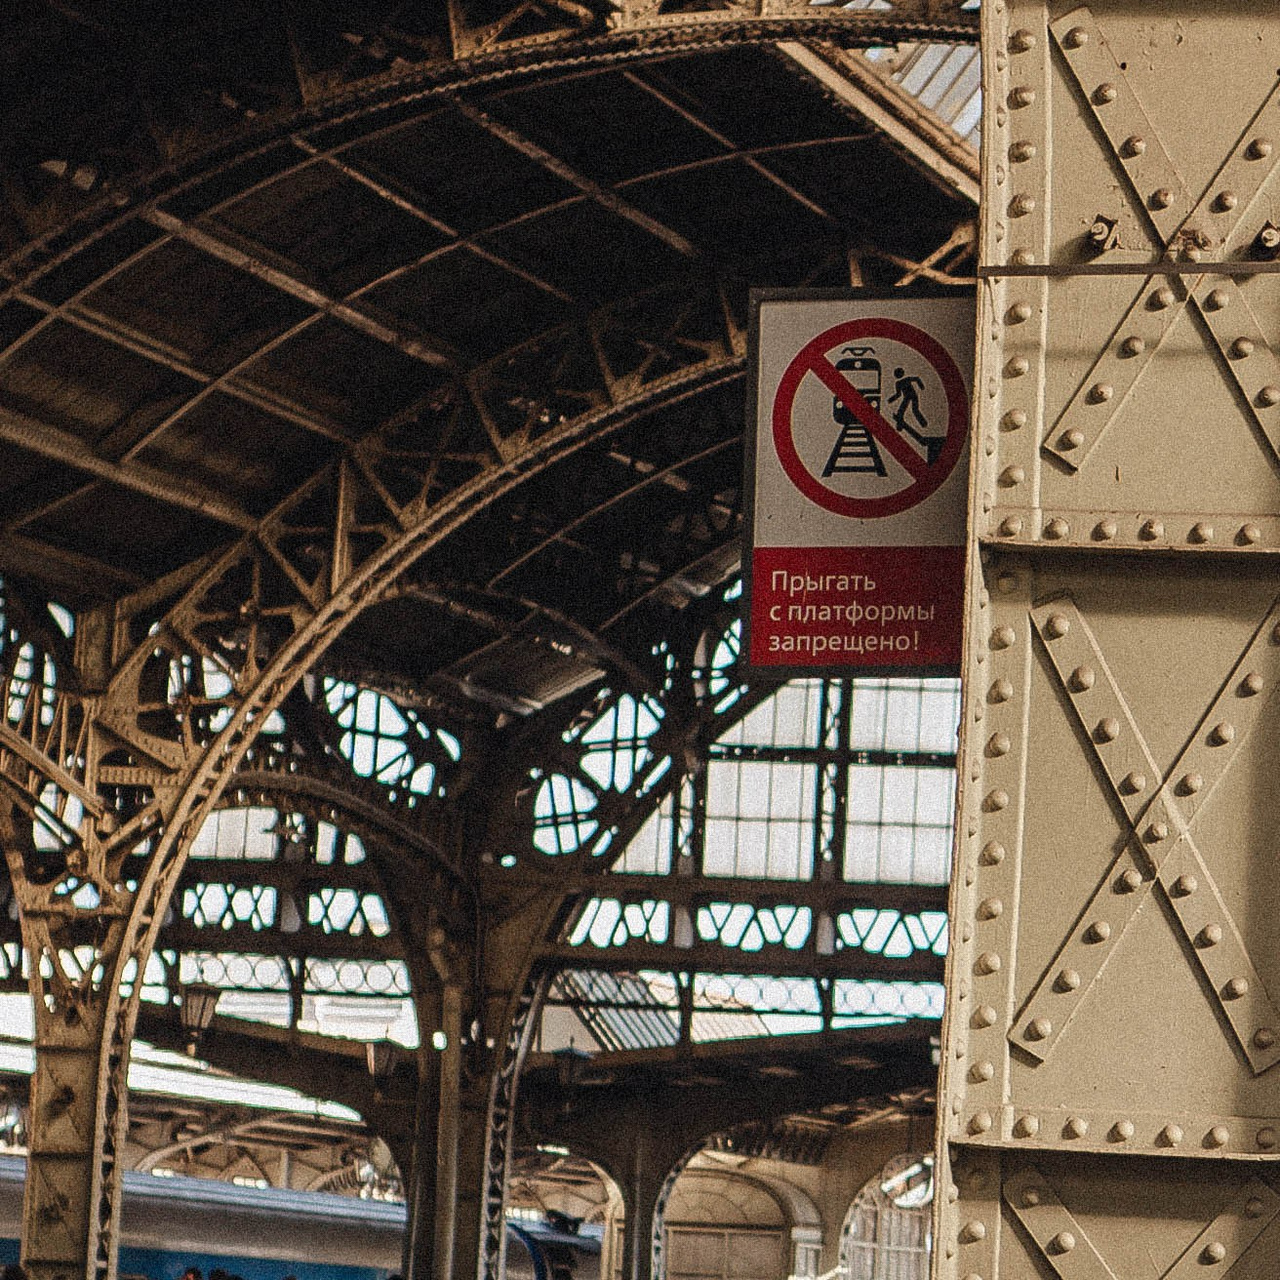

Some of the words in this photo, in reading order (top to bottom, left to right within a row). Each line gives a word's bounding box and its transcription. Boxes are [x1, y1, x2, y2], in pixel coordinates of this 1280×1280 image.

[772, 570, 876, 597] Прыгать
[769, 605, 781, 621] с
[788, 600, 935, 627] платформы
[768, 630, 920, 657] запрещено!
